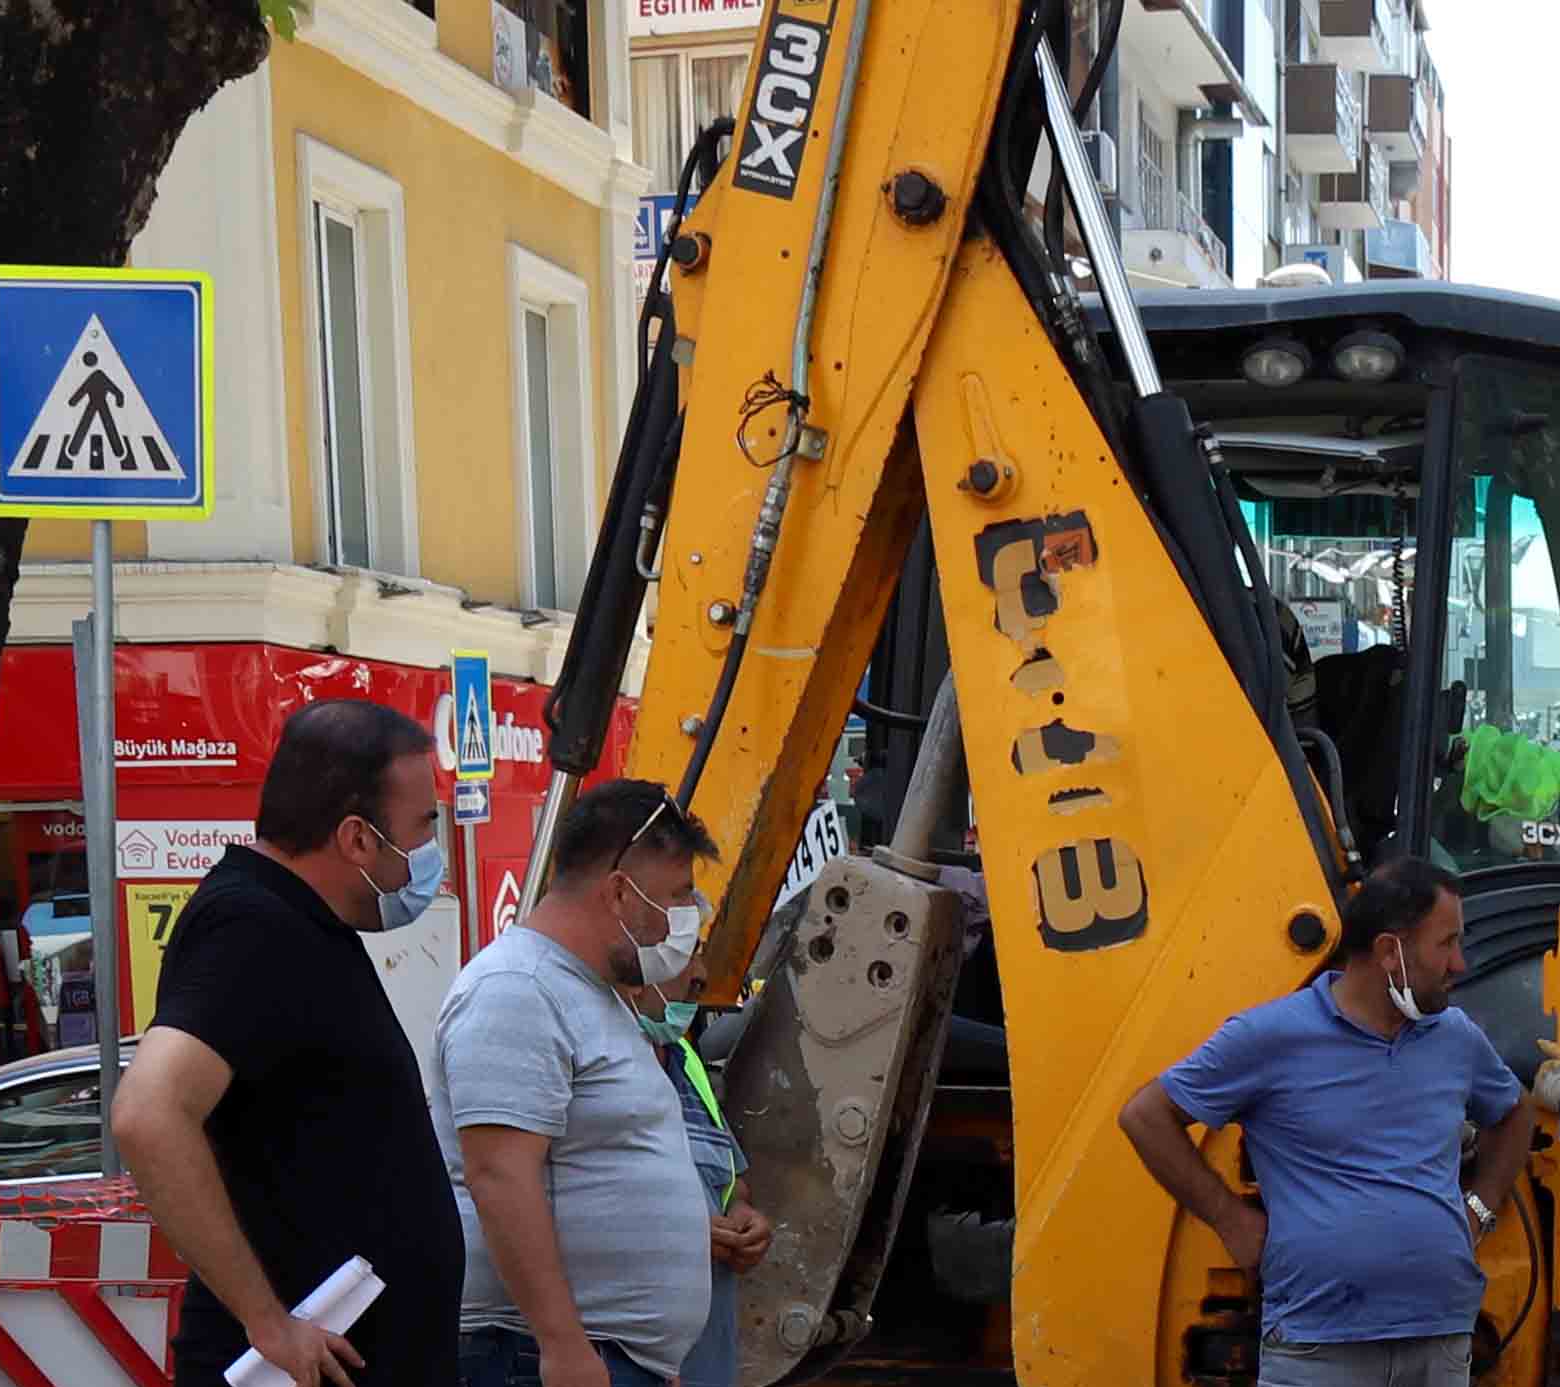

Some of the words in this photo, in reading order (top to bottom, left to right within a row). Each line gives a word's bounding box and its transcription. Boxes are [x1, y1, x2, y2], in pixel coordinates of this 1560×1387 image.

[740, 22, 821, 178] 3CX
[114, 739, 168, 759] Büyük
[171, 739, 236, 759] Mağaza
[165, 829, 254, 847] Vodafone
[166, 852, 213, 870] Evde
